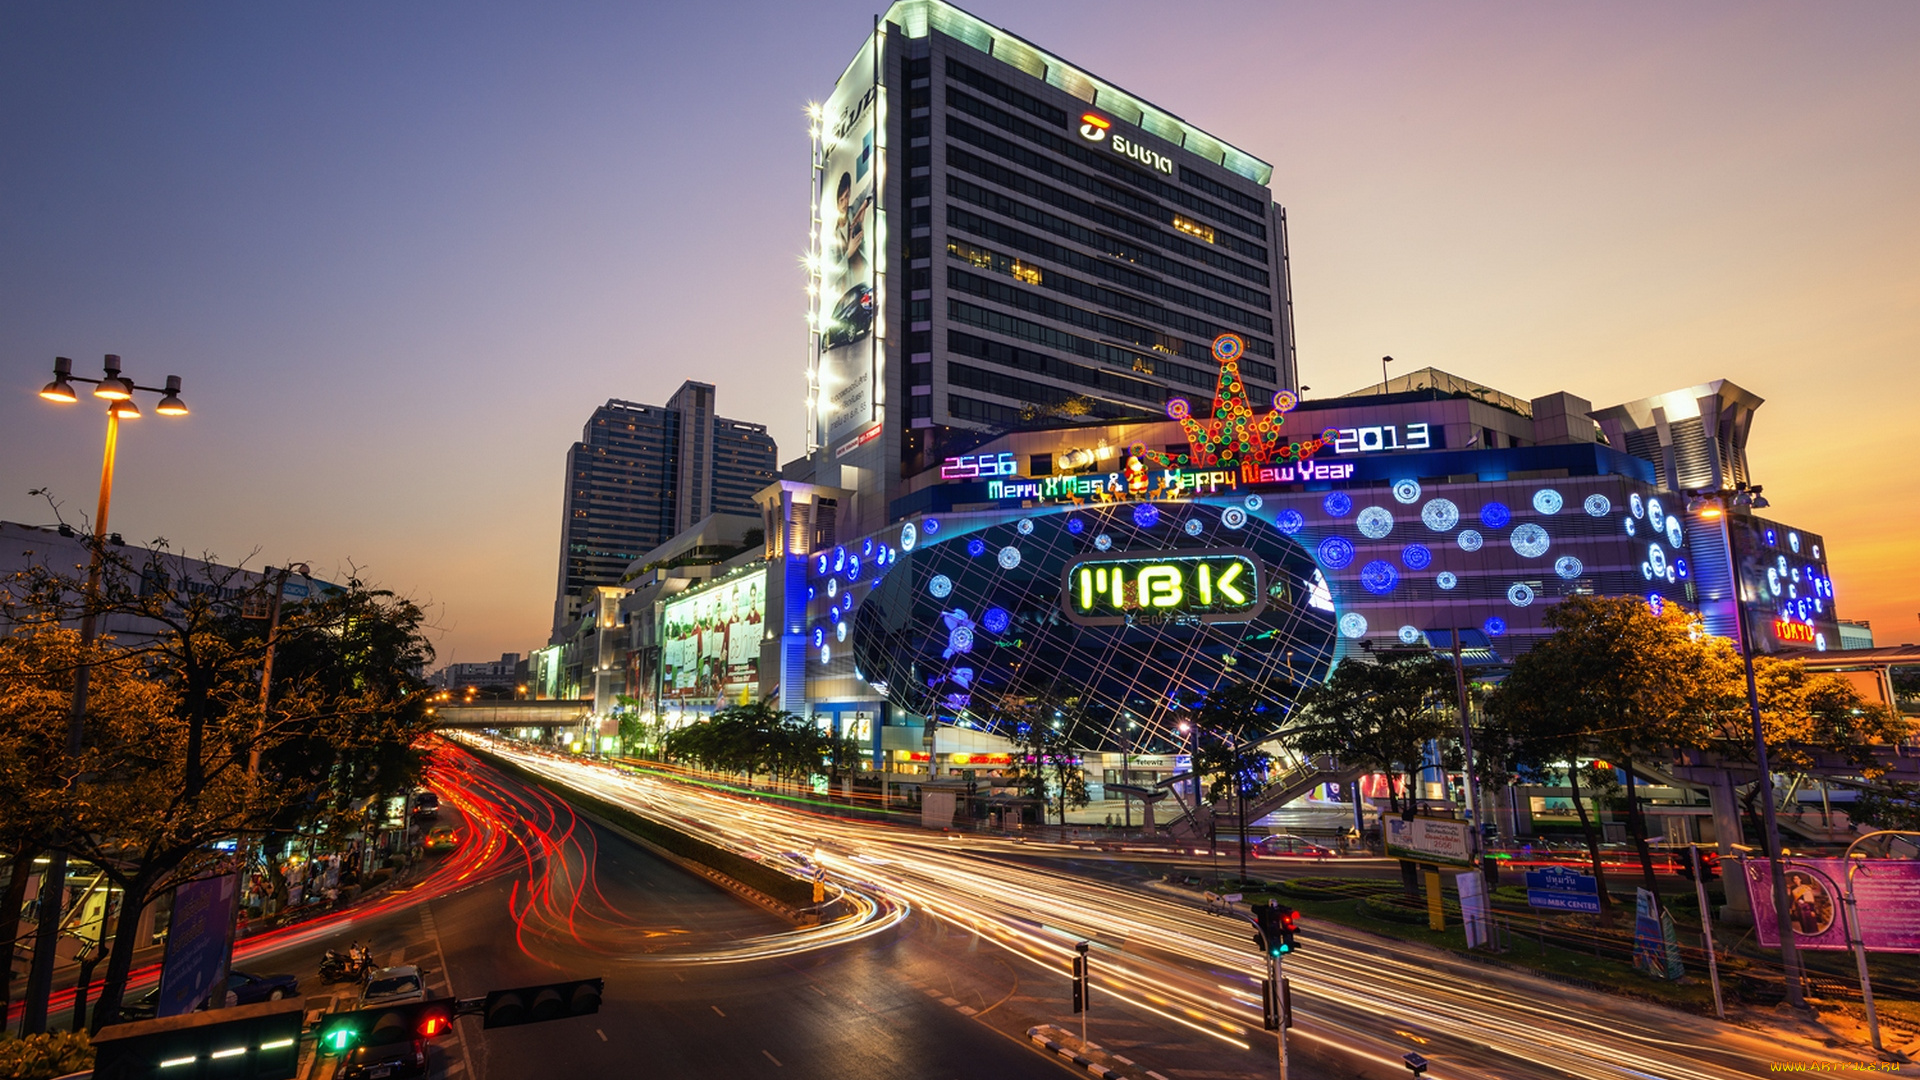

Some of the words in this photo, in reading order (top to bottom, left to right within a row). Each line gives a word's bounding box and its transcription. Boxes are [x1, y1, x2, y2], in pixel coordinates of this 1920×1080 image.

[1112, 134, 1173, 174] ธนชาต
[1335, 423, 1430, 454] 2013
[941, 452, 1017, 479] 2556
[988, 480, 1043, 502] Merry
[1045, 474, 1104, 496] X'Mas
[1164, 468, 1236, 493] Happy
[1241, 463, 1294, 484] New
[1298, 460, 1354, 480] Year
[1080, 562, 1246, 610] MBK
[1776, 622, 1813, 641] TOKYU
[1547, 898, 1566, 907] MBK
[1567, 901, 1598, 910] CENTER
